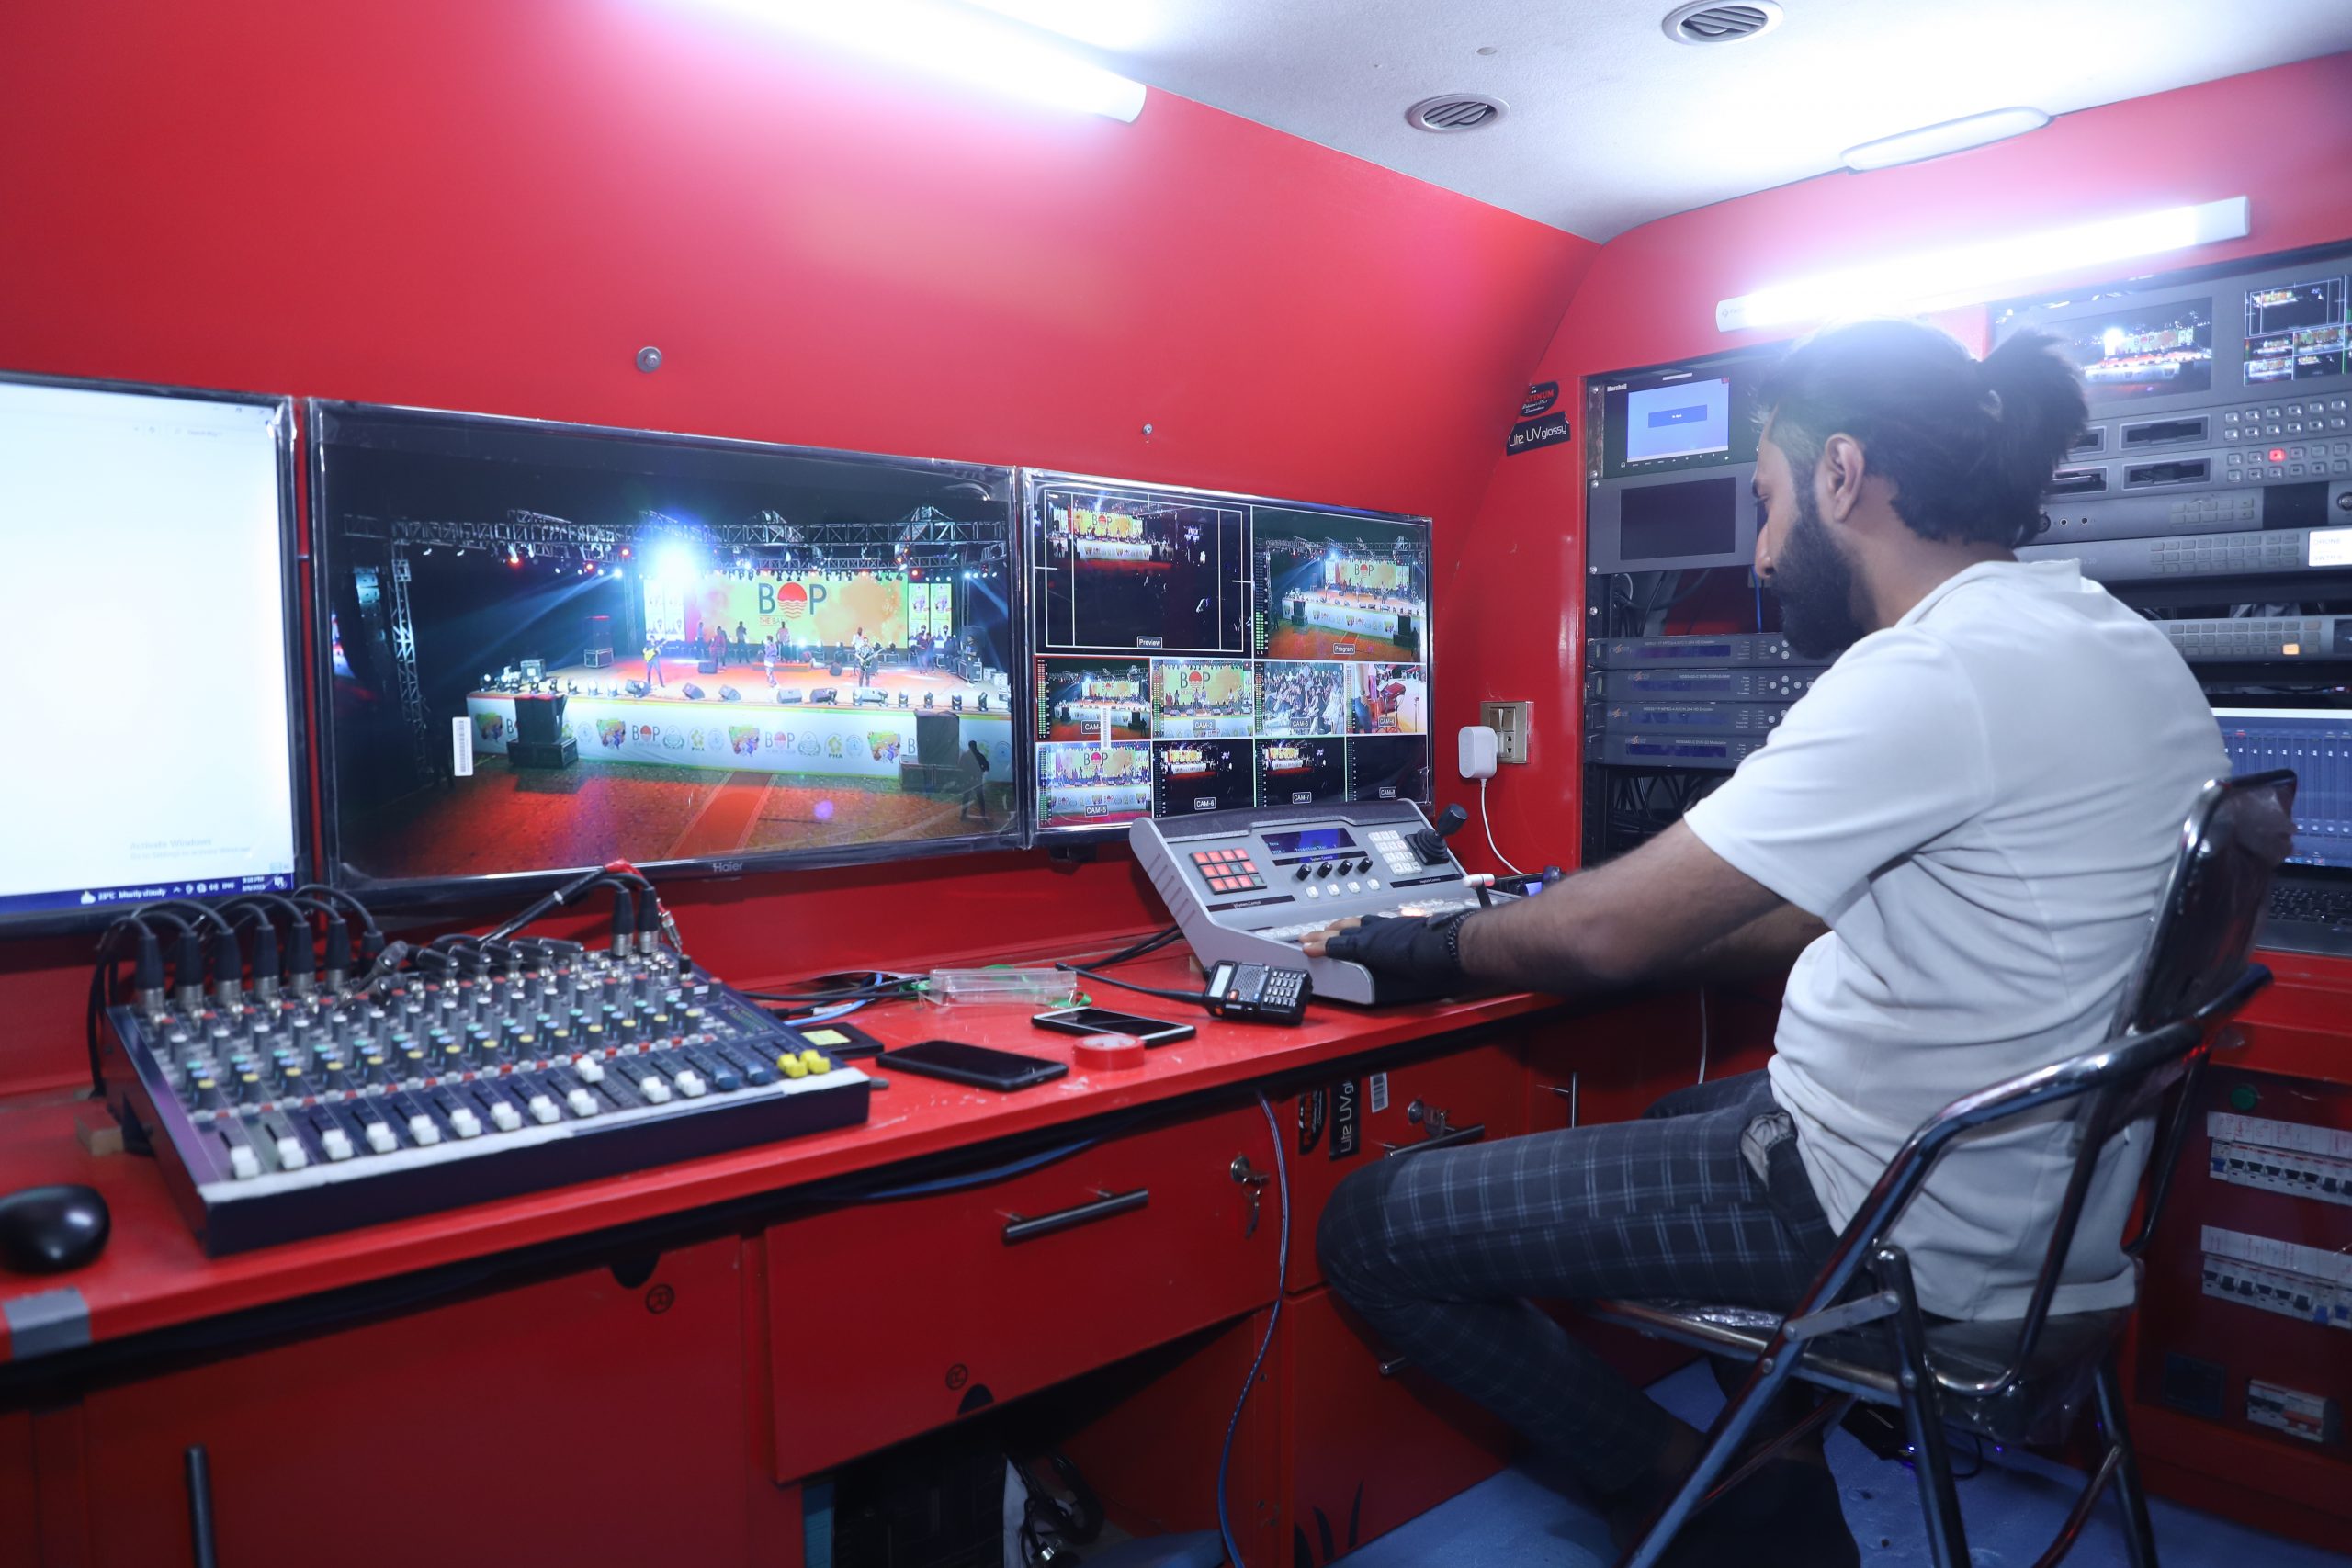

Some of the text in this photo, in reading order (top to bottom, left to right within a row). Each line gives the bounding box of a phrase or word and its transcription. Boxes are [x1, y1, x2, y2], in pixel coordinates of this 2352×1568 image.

[1354, 563, 1374, 577] BOP
[758, 581, 827, 619] BOP
[1138, 638, 1161, 647] Preview
[1334, 645, 1354, 653] Program
[1180, 671, 1211, 690] BOP
[1084, 722, 1102, 731] CAM-
[1292, 719, 1309, 728] CAM-3
[632, 725, 660, 742] BOP
[765, 731, 795, 749] BOP
[1084, 751, 1108, 766] BOP
[1196, 799, 1215, 807] CAM-6
[1293, 793, 1311, 802] CAM-7
[713, 861, 742, 873] Haier
[119, 889, 142, 899] Mostly
[143, 887, 166, 897] cloudy
